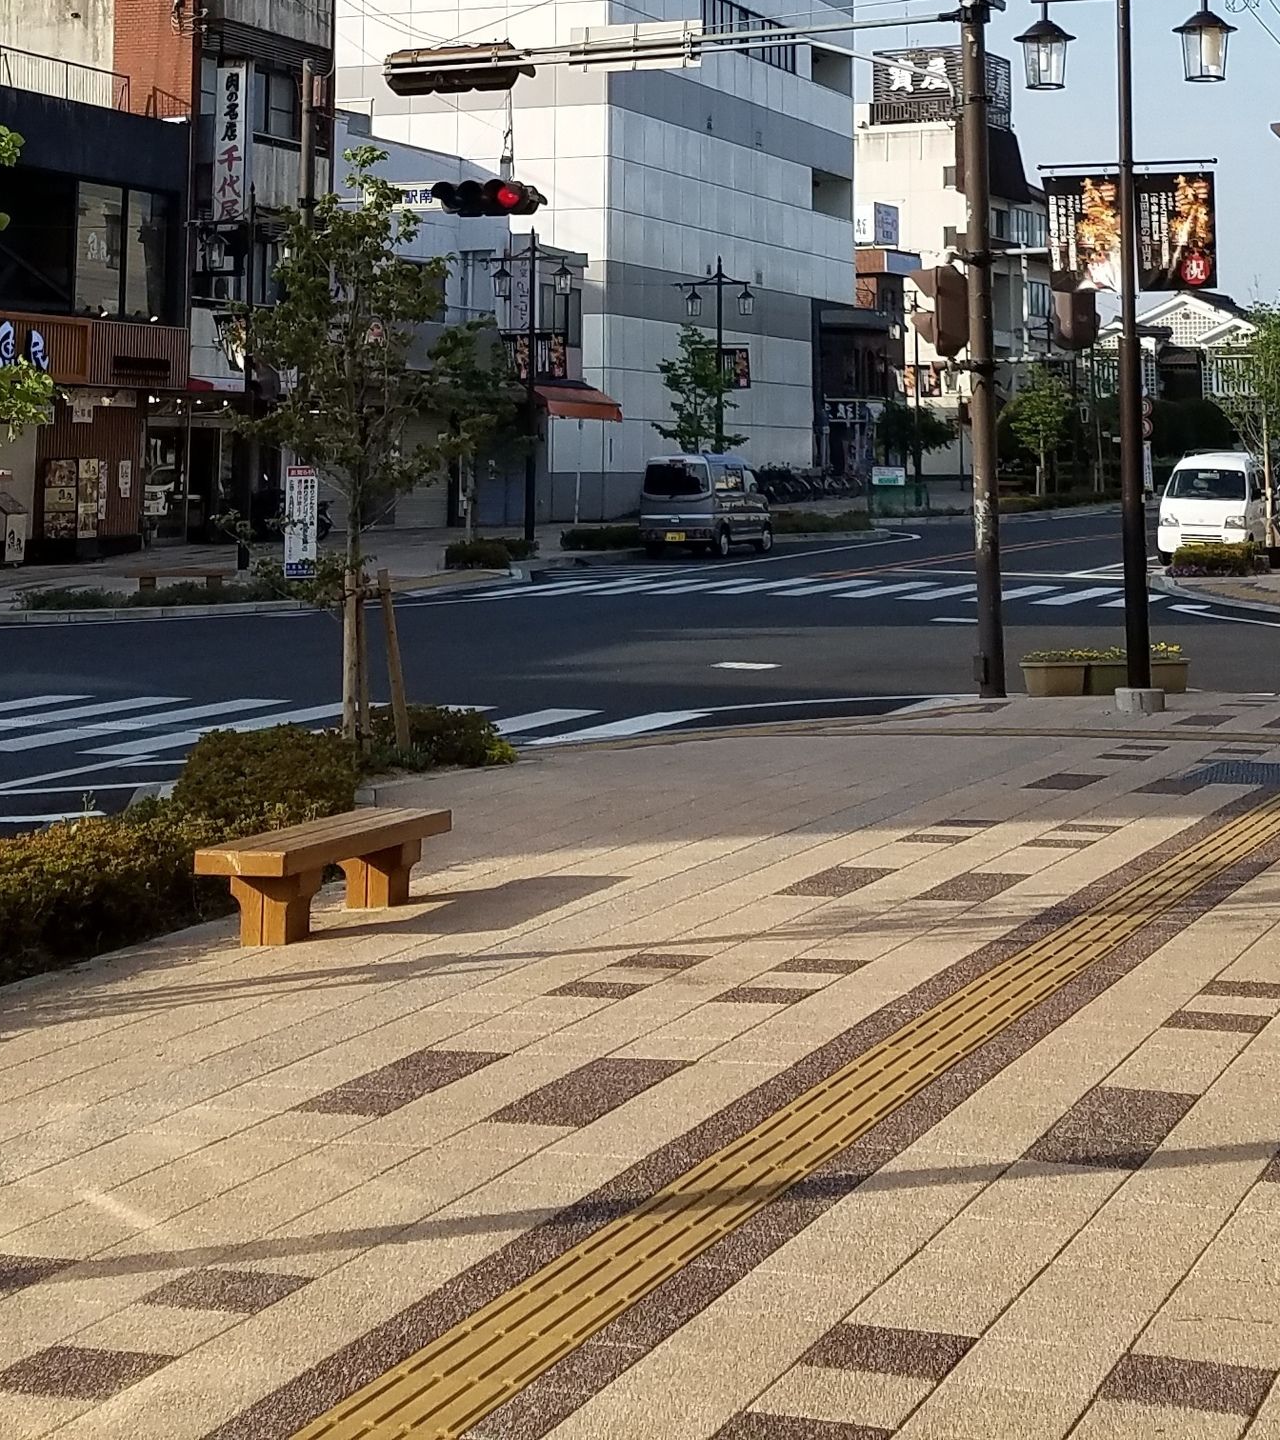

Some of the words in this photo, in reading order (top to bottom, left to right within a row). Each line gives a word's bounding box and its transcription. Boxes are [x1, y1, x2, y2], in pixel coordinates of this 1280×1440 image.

[221, 72, 240, 142] 肉の名店
[216, 144, 242, 221] 千代屋
[1186, 259, 1206, 281] 祝
